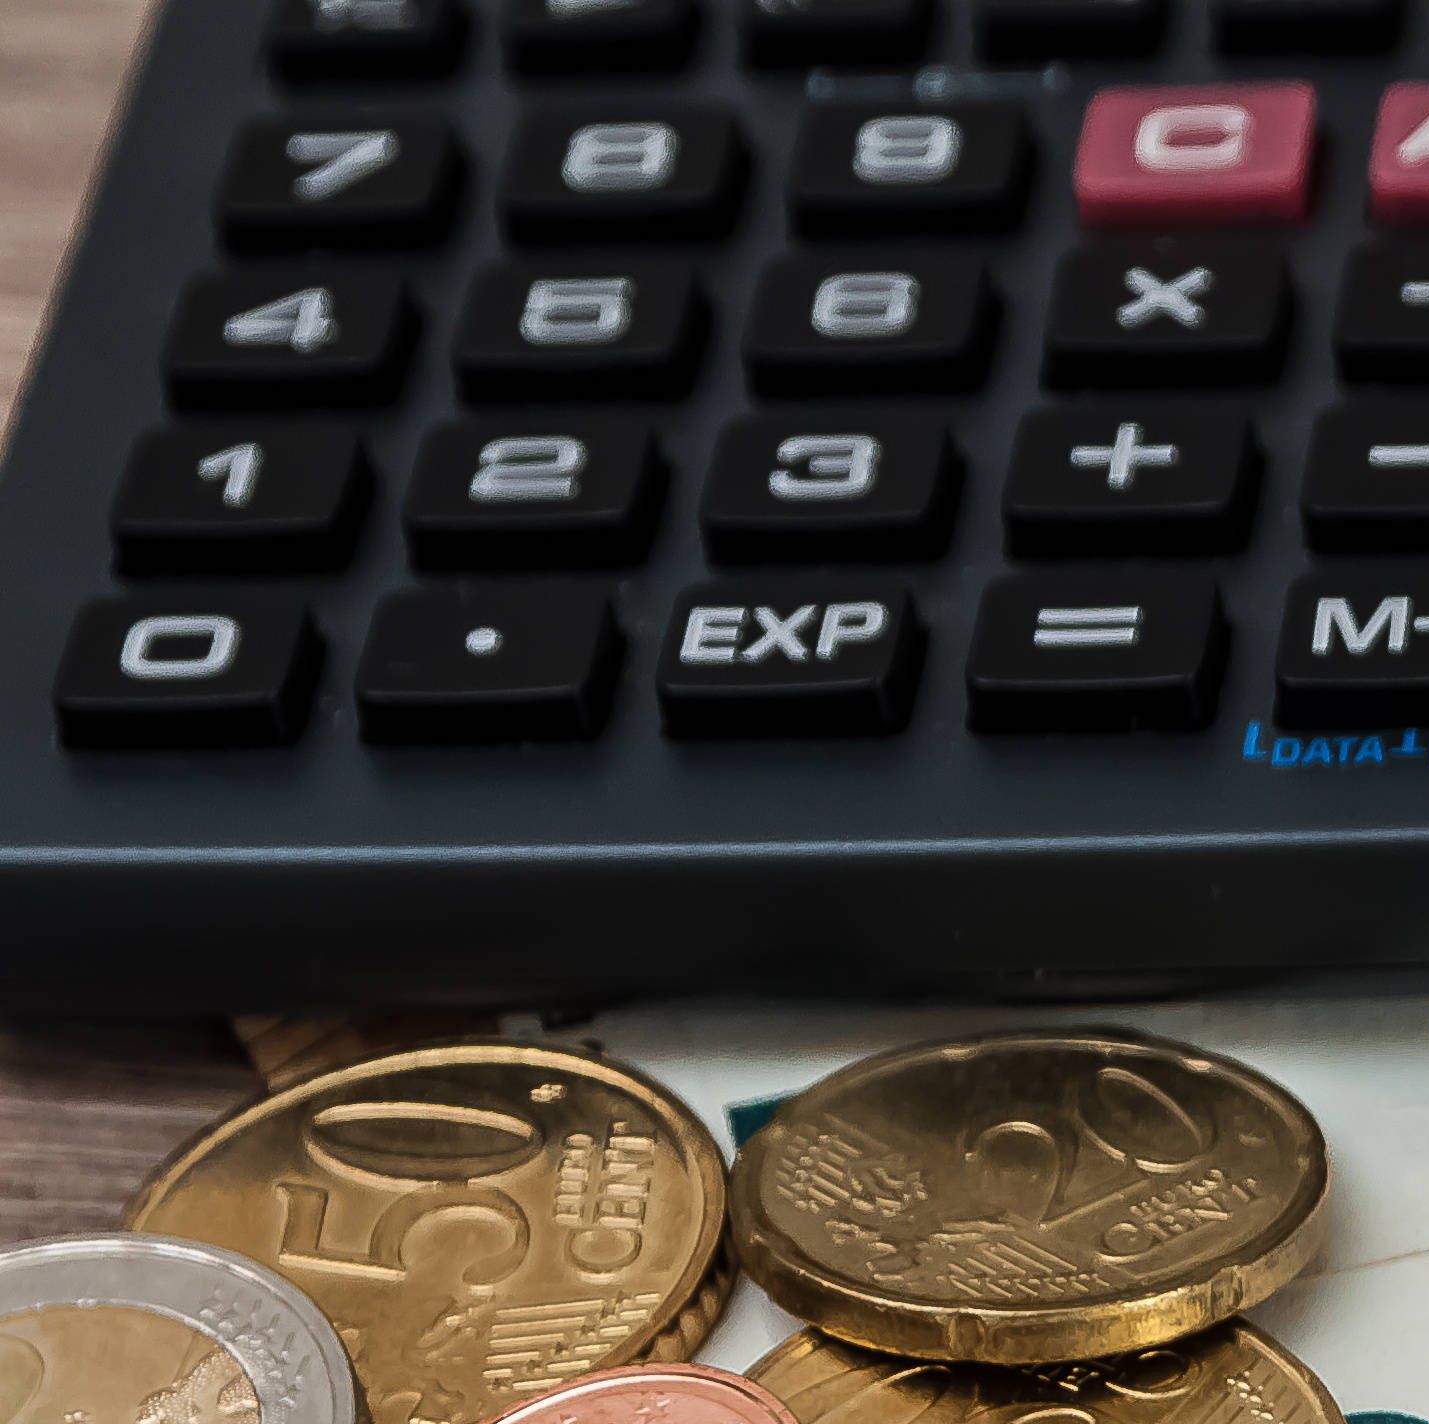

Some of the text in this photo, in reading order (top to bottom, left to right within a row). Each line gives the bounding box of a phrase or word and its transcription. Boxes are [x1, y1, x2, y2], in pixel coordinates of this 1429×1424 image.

[286, 129, 398, 199] 7
[560, 121, 677, 192] 8
[853, 114, 961, 183] 9
[1133, 103, 1252, 170] C
[222, 287, 335, 352] 4
[519, 277, 632, 345] 5
[810, 272, 920, 337] 6
[198, 442, 262, 507] 1
[469, 435, 586, 502] 2
[768, 434, 880, 498] 3
[120, 615, 240, 679] 0
[679, 601, 888, 664] EXP
[1272, 736, 1384, 768] DATA
[963, 1063, 1218, 1232] 20
[275, 1100, 546, 1298] 50
[562, 1118, 658, 1286] CENT
